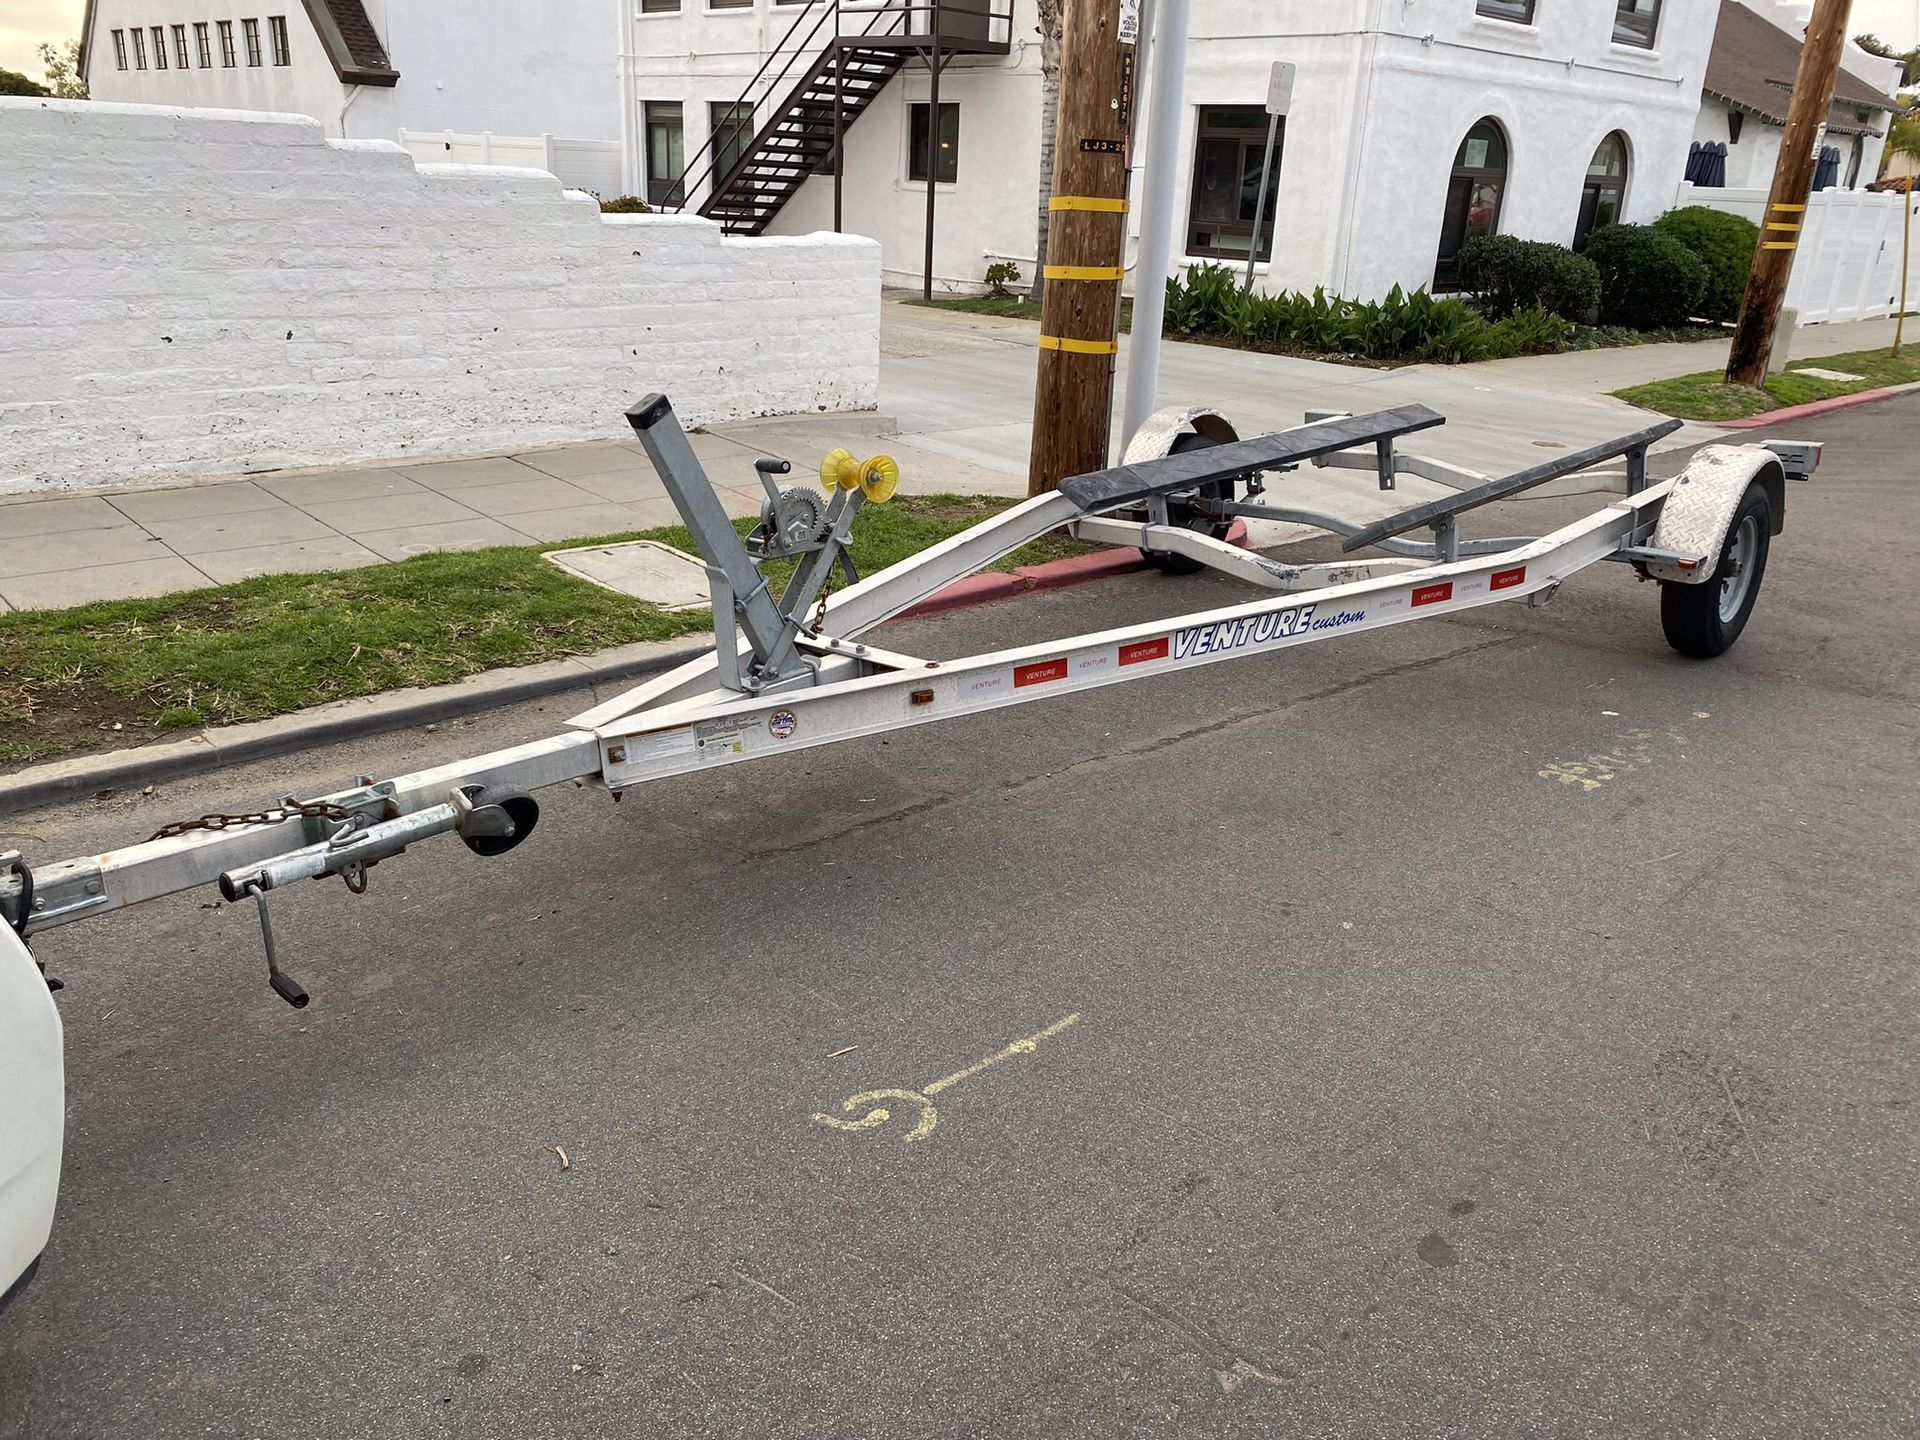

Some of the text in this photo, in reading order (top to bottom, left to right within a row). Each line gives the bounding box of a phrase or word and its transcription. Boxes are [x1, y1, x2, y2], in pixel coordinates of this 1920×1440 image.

[1420, 590, 1444, 601] VENTURE
[1174, 603, 1366, 660] VENTURE custom
[1129, 646, 1158, 659] VENTURE
[1079, 657, 1107, 669] VENTURE
[1025, 667, 1057, 680] VENTURE
[971, 678, 1002, 690] VENTURE
